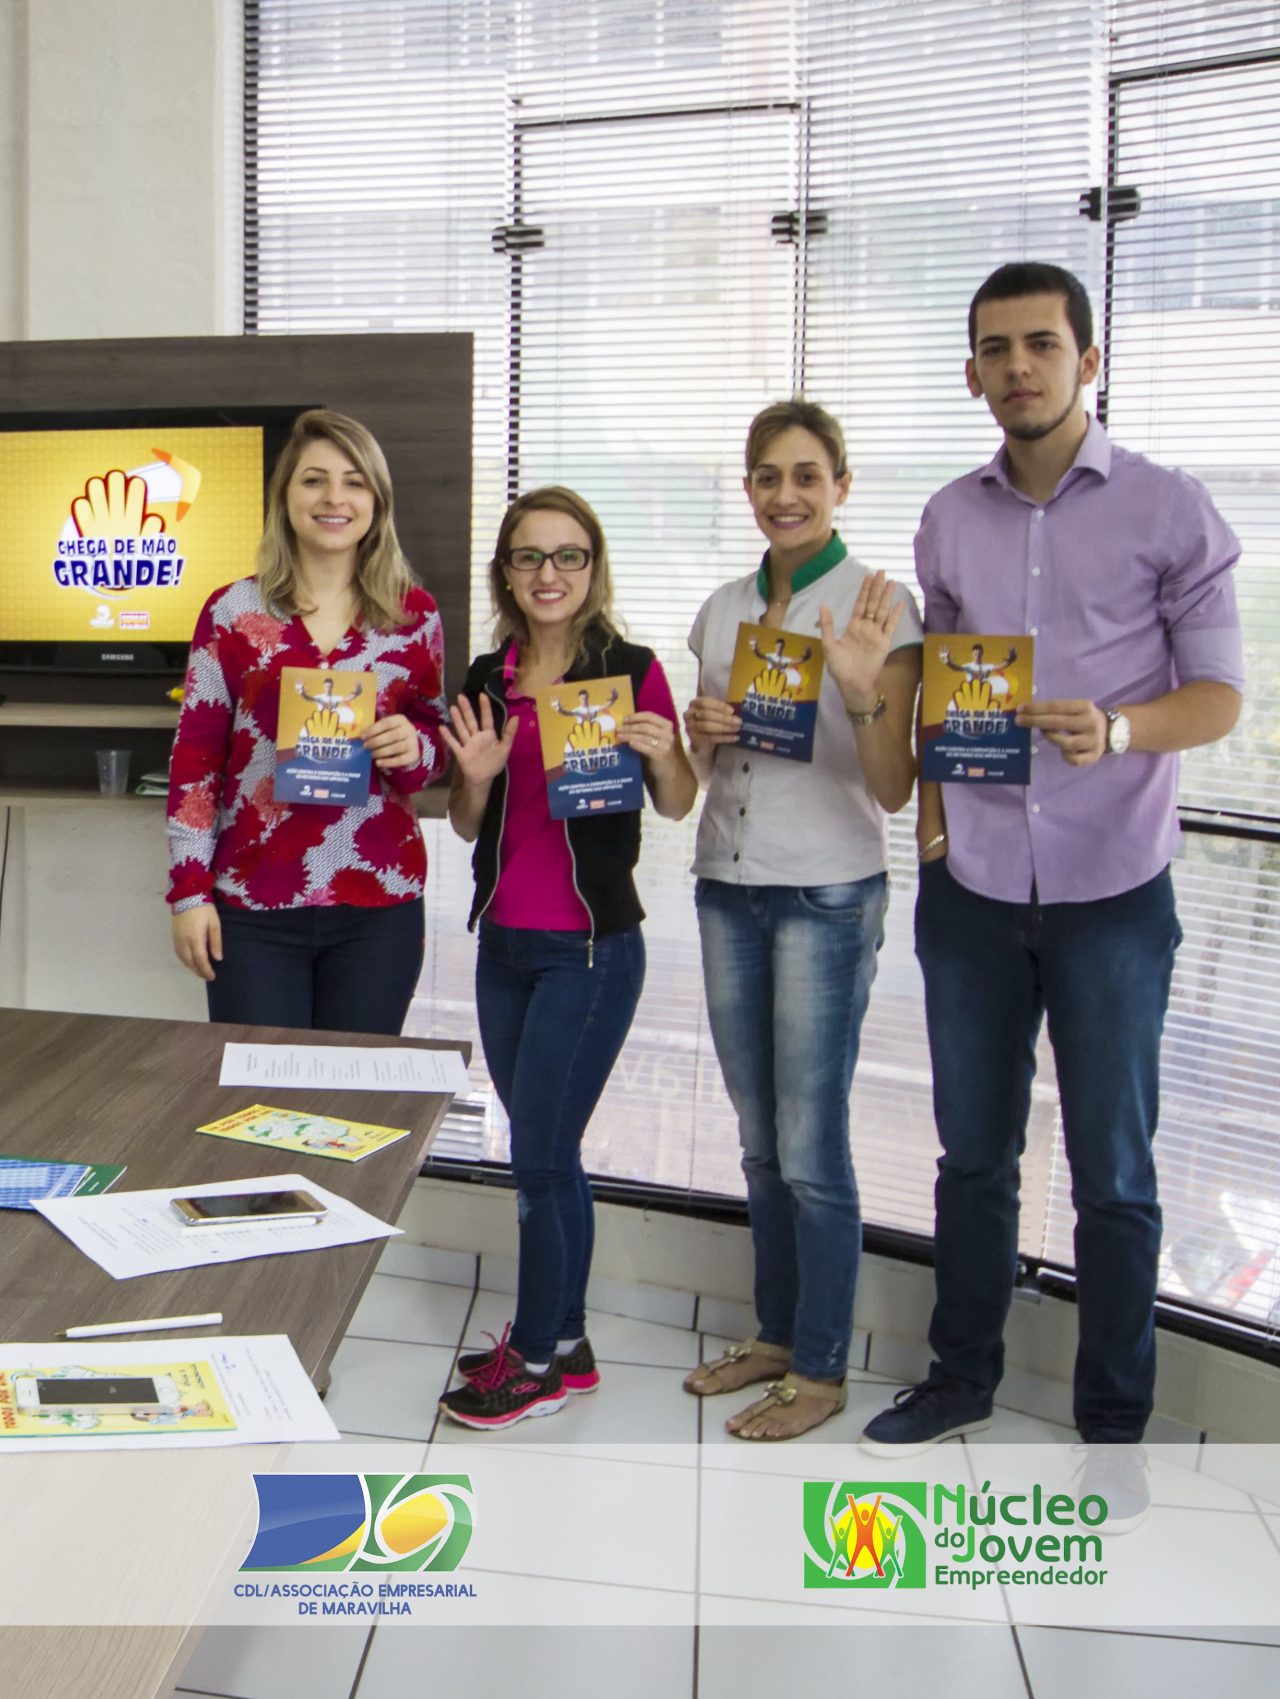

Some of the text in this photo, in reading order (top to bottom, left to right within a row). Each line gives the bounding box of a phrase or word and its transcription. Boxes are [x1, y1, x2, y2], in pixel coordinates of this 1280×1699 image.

[58, 535, 177, 555] CHEGA DE MÃO
[53, 558, 185, 587] GRANDE!
